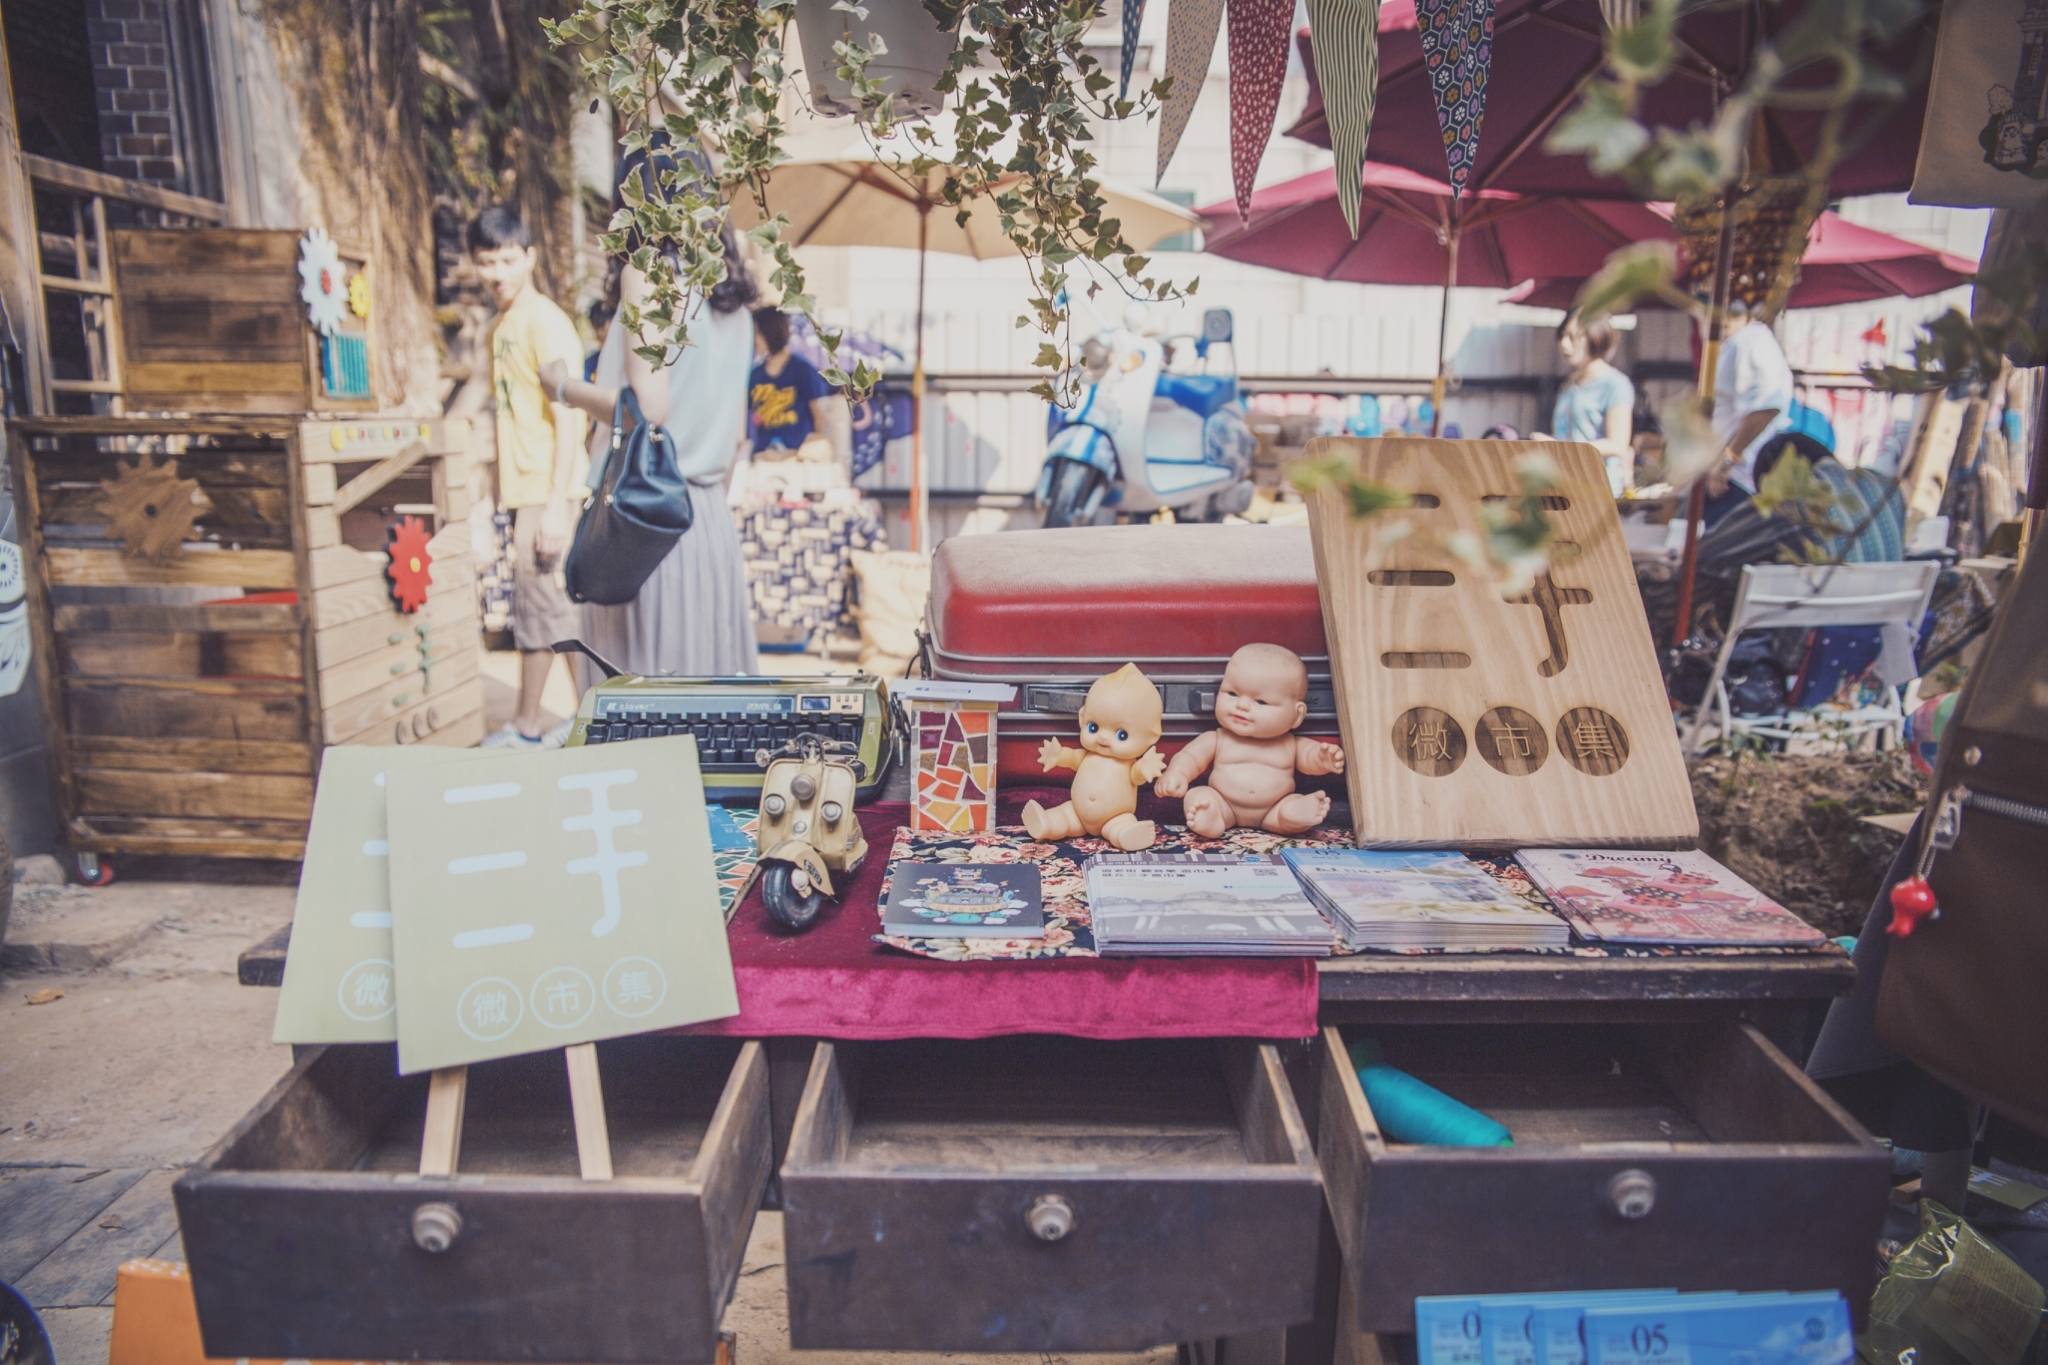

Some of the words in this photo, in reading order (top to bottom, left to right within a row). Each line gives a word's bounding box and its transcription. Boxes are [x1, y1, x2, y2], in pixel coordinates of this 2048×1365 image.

[619, 702, 649, 711] clover
[1408, 721, 1615, 762] 微市集
[472, 968, 655, 1026] 微市集
[1631, 1322, 1669, 1357] 05
